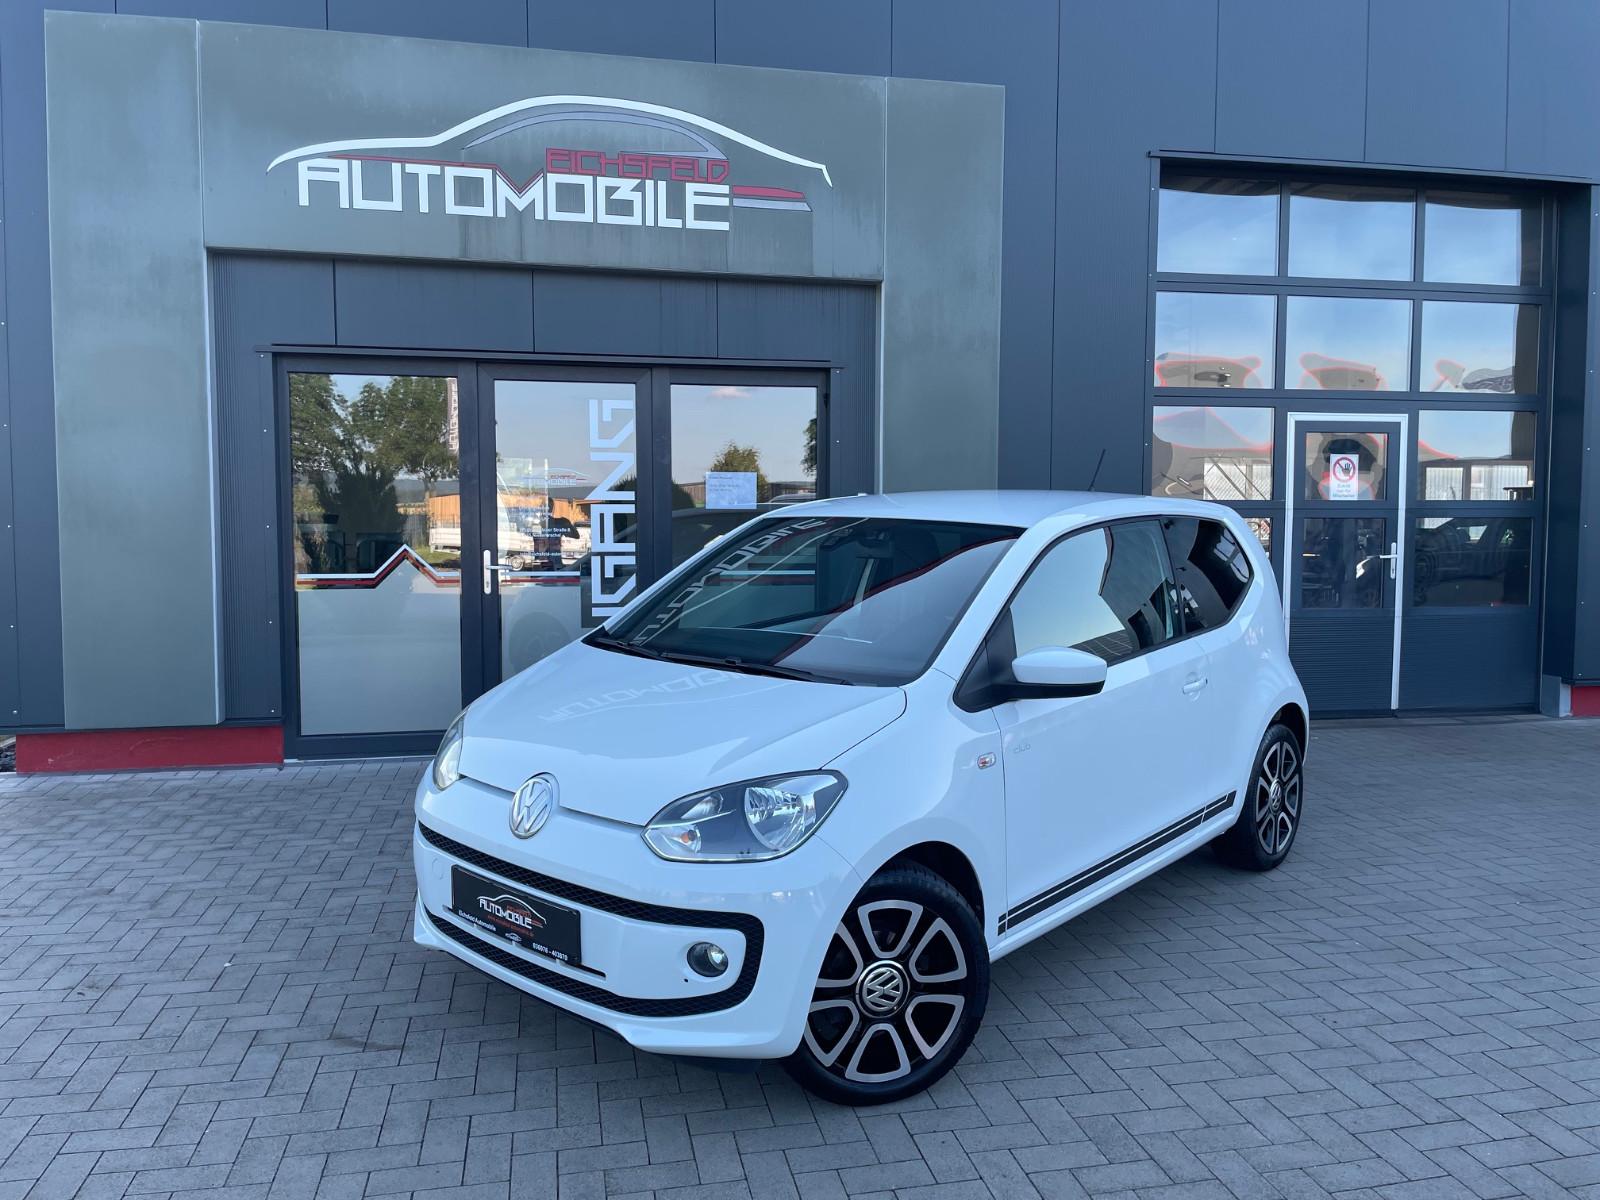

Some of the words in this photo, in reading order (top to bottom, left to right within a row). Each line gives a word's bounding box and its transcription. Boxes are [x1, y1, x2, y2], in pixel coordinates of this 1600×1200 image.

[545, 147, 730, 183] EICHSFELD
[298, 158, 730, 231] AUTOMOBILE
[479, 899, 533, 929] AUTOMOBILE
